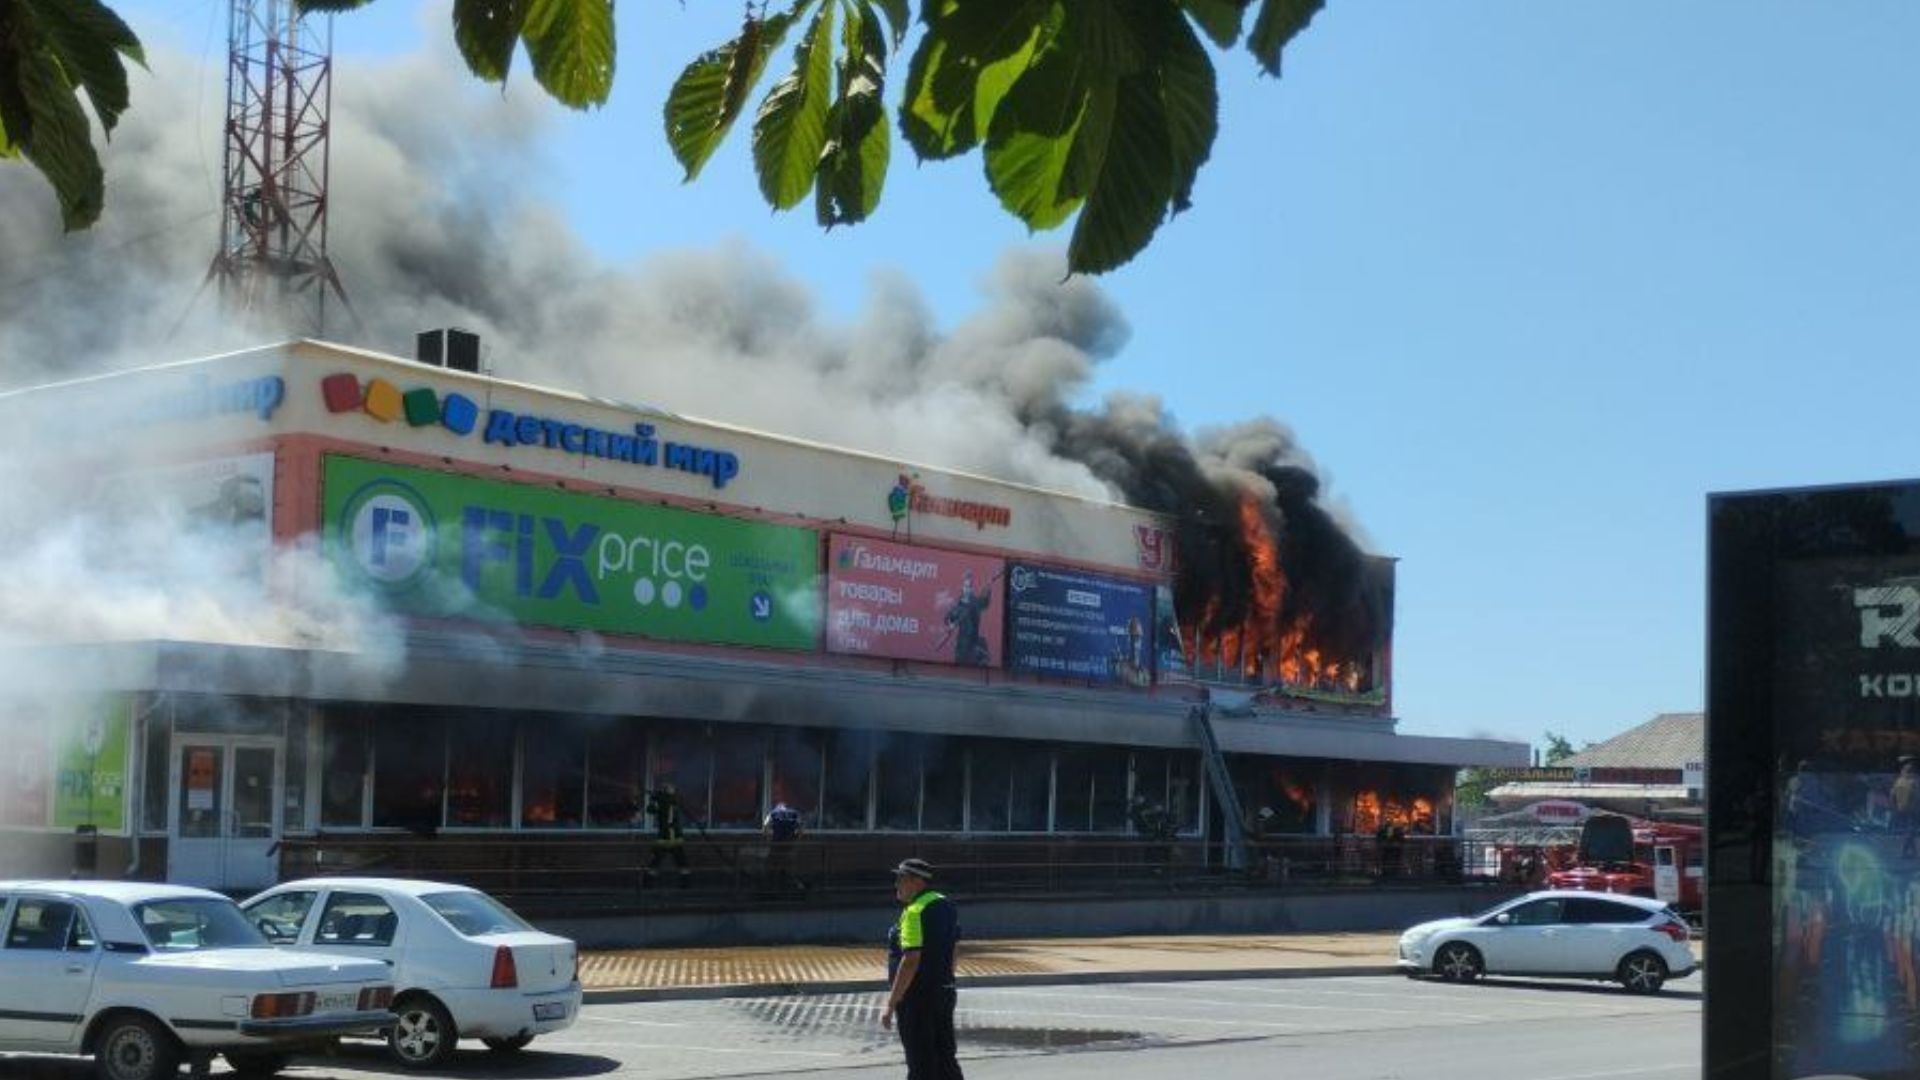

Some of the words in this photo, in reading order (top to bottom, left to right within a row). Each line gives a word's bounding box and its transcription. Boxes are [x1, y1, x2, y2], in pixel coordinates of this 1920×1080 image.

[484, 409, 658, 466] детский
[664, 442, 739, 489] мир
[599, 532, 711, 581] price
[853, 546, 939, 582] Галамарт
[839, 580, 903, 608] товары
[874, 614, 920, 636] дома
[1859, 674, 1920, 697] КО
